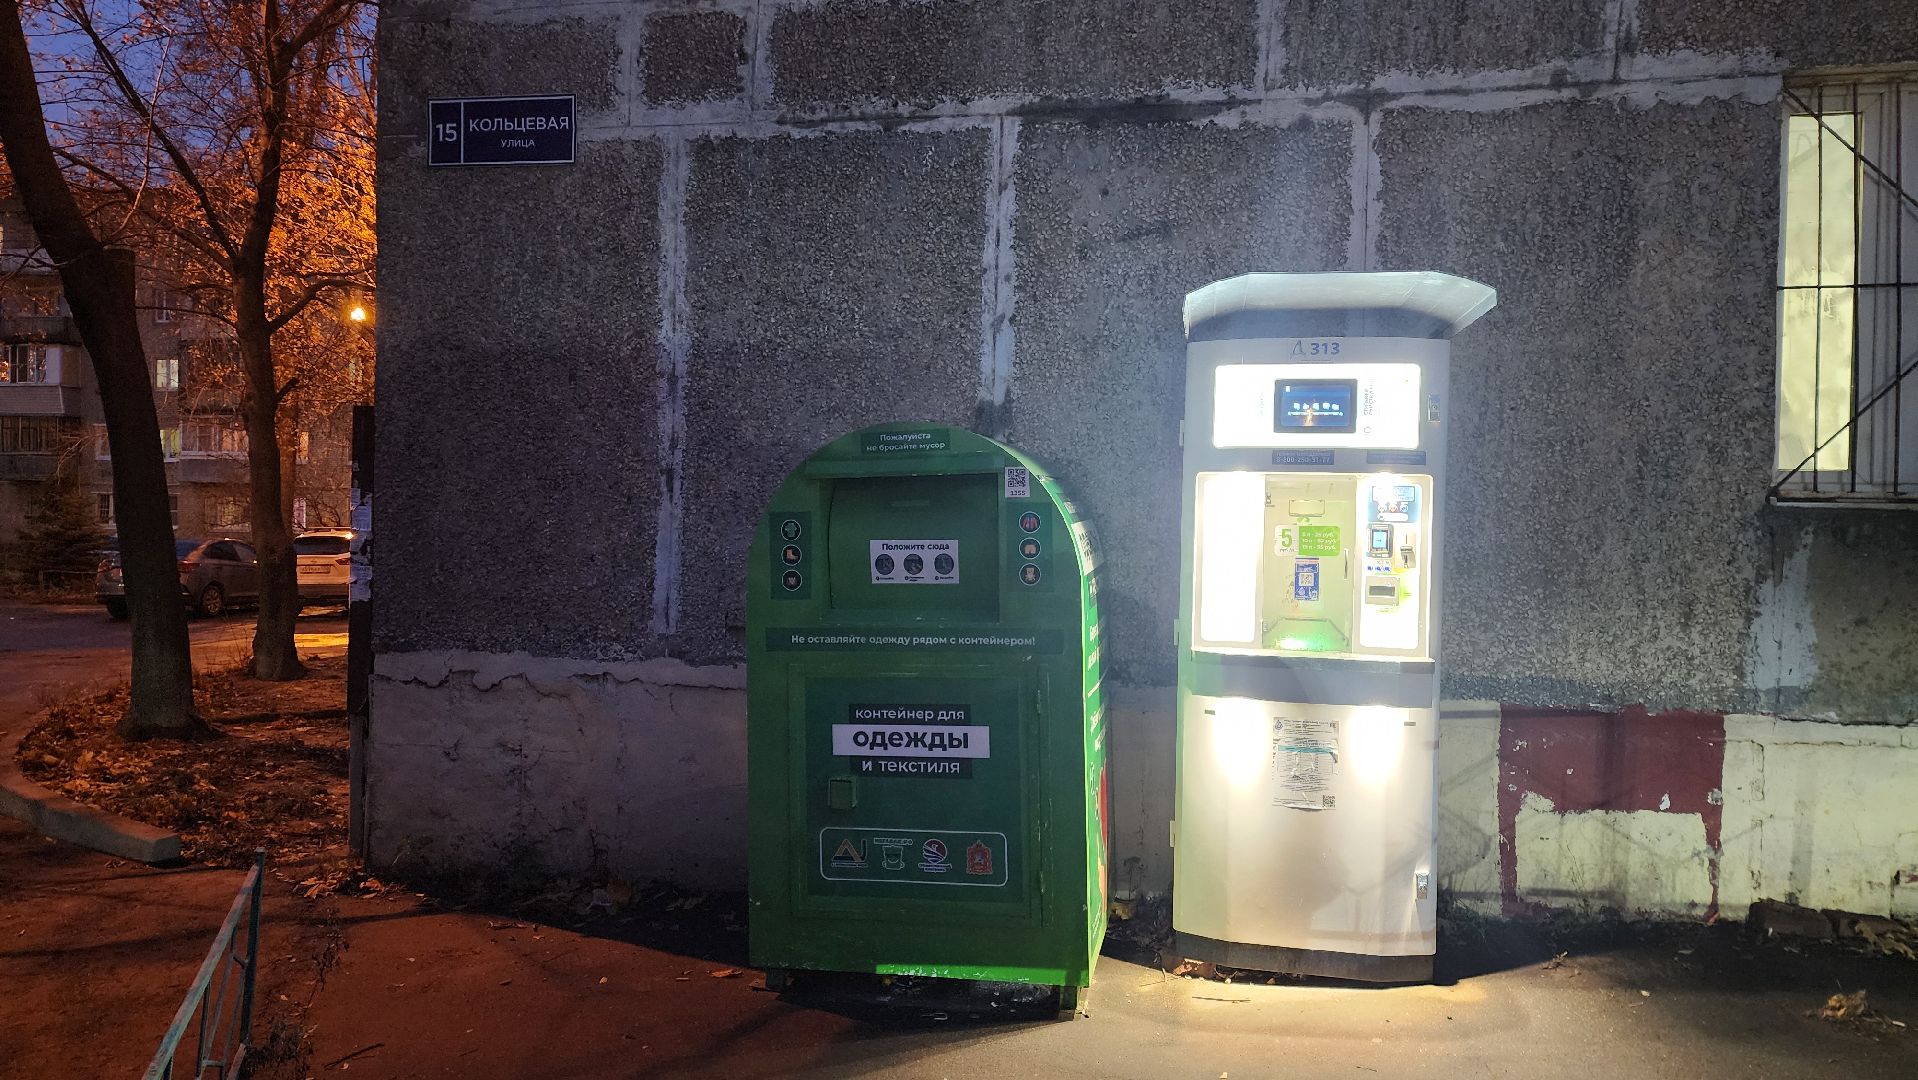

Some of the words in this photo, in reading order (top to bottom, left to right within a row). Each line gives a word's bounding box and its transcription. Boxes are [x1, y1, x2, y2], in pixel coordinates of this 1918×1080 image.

[469, 116, 570, 133] КОЛЬЦЕВАЯ
[436, 123, 457, 142] 15
[500, 139, 535, 149] УЛИЦА
[1310, 342, 1340, 356] 313
[880, 432, 931, 442] Пожалуйста
[866, 444, 878, 452] не
[879, 443, 917, 453] бросайте
[919, 441, 946, 451] мусор
[1281, 528, 1293, 548] 5
[882, 543, 925, 551] Положите
[927, 543, 950, 551] сюда
[791, 635, 805, 644] Не
[807, 634, 866, 644] оставляйте
[868, 636, 911, 646] одежду
[912, 636, 947, 646] рядом
[958, 635, 1036, 647] контейнером!
[855, 707, 934, 722] контейнер
[937, 710, 965, 721] для
[852, 730, 969, 752] одежды
[862, 760, 873, 772] и
[878, 760, 961, 774] текстиля
